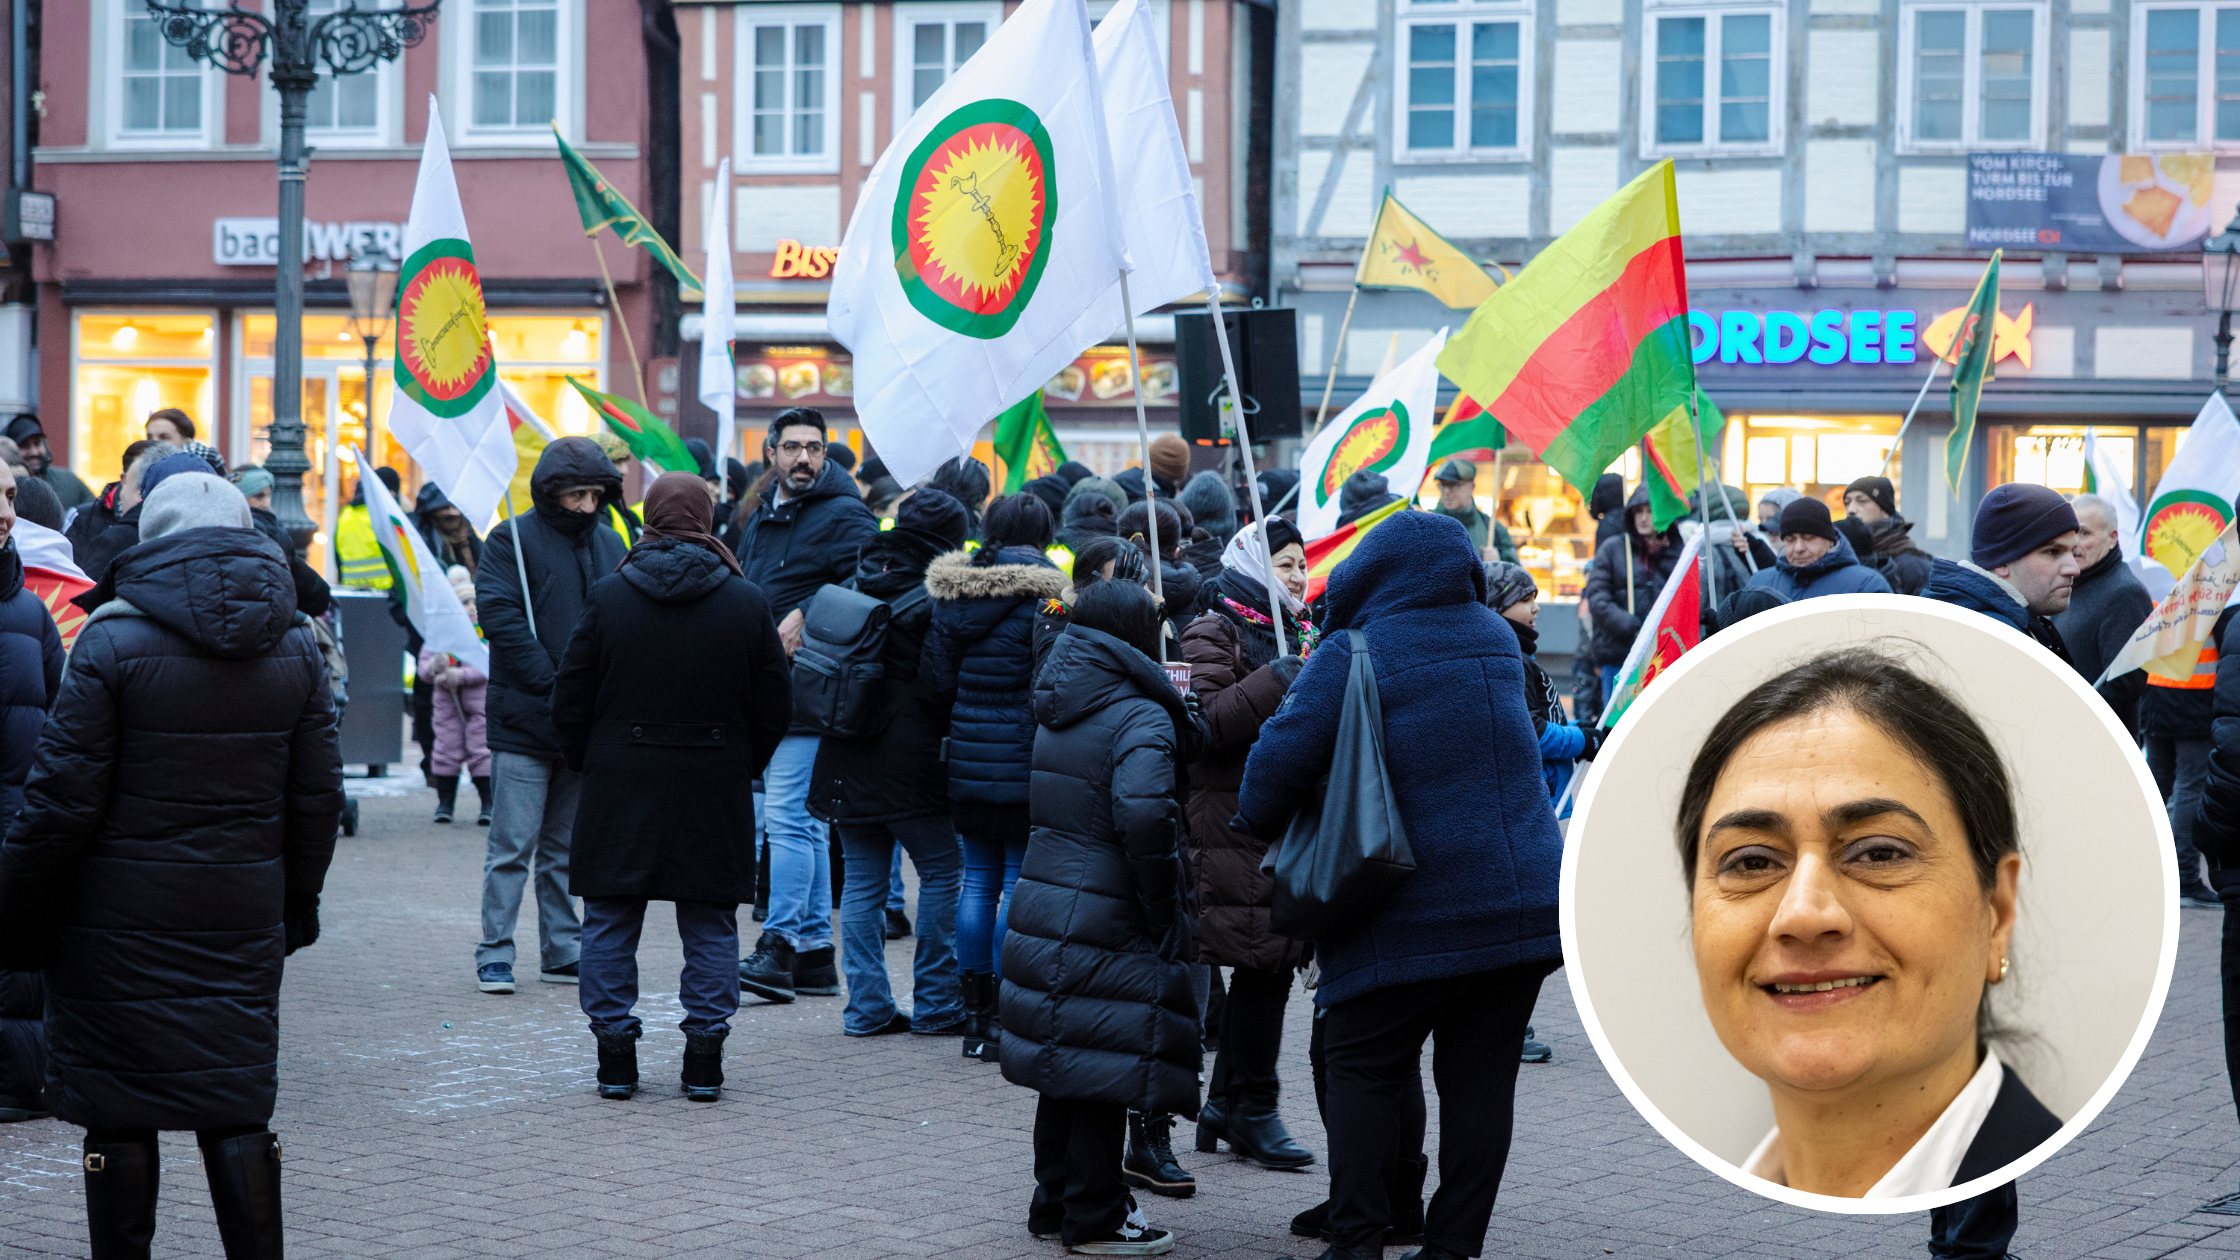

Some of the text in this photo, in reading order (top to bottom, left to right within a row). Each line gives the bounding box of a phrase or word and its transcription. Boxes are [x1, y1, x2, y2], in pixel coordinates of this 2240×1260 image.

[1970, 155, 2007, 170] VOM
[1972, 171, 2073, 187] TURM BIS ZUR
[1969, 227, 2037, 243] NORDSEE
[1688, 308, 1917, 365] ORDSEE
